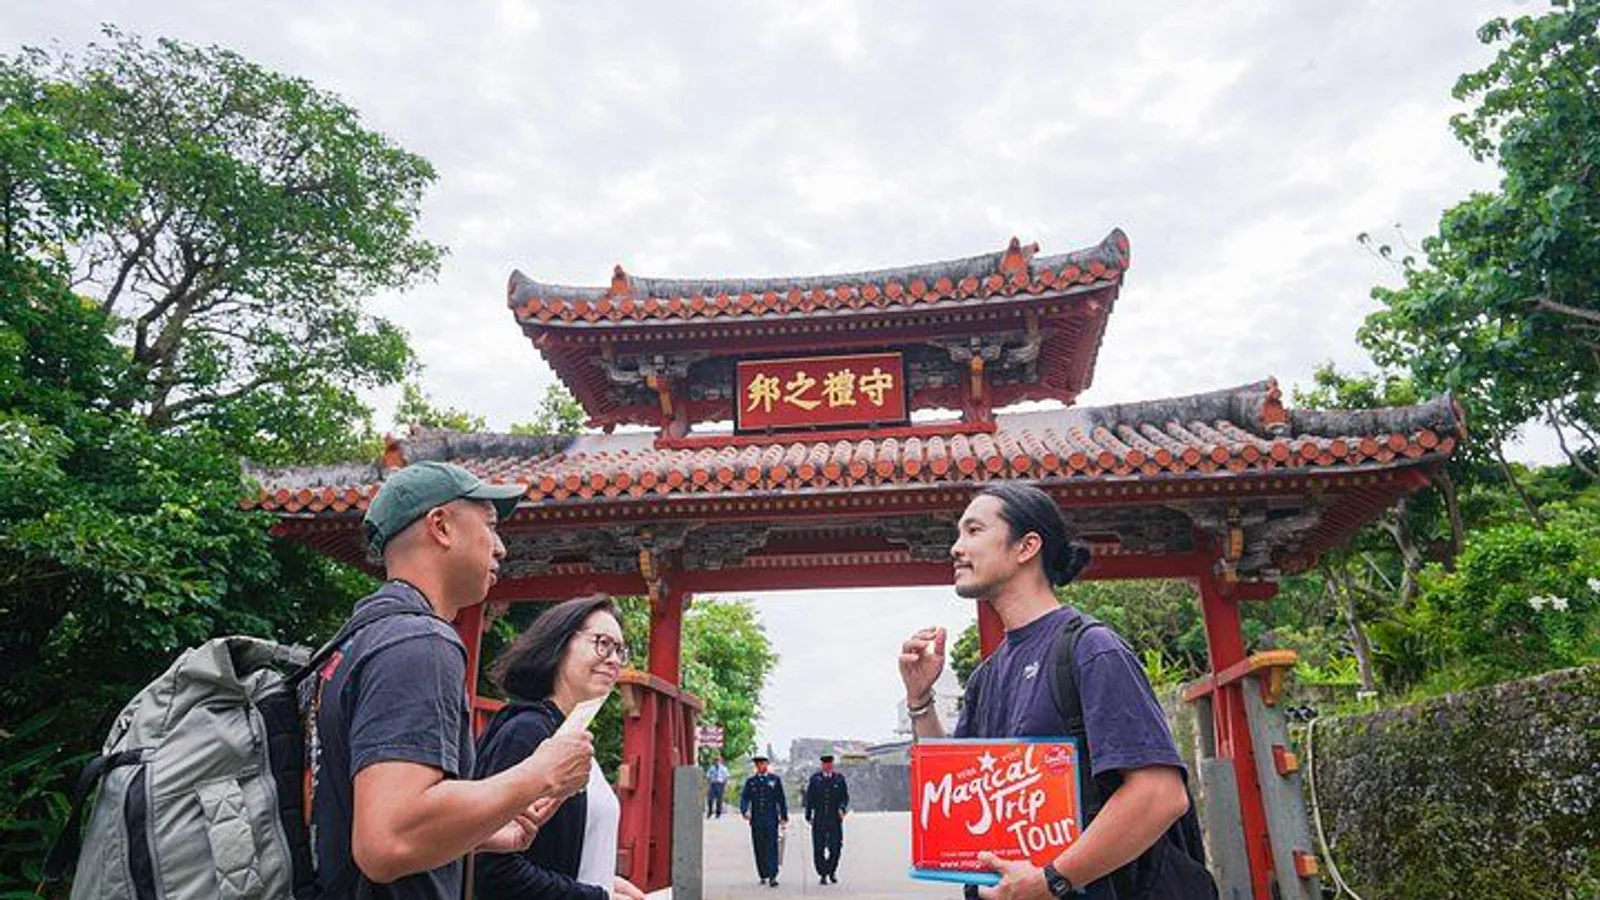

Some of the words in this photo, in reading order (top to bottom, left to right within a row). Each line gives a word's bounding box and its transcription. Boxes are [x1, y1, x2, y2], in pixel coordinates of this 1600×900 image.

[921, 744, 1039, 835] Magical
[989, 775, 1045, 823] Trip
[1007, 818, 1074, 857] Tour
